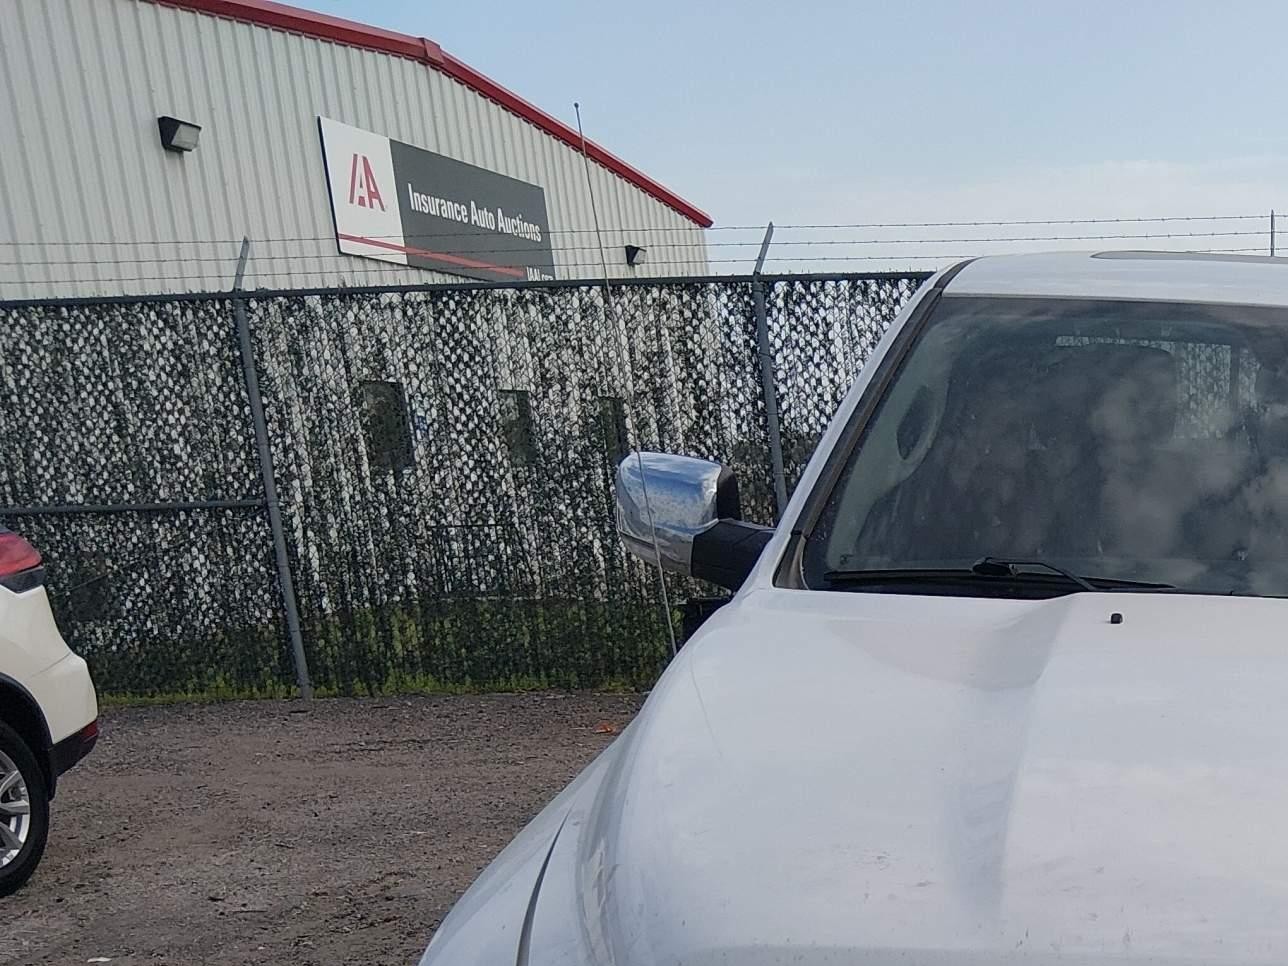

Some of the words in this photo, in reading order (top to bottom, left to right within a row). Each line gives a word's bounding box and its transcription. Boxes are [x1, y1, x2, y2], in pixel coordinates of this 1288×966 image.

[407, 182, 469, 224] Insurance
[470, 200, 496, 231] Auto
[497, 207, 542, 242] Auctions
